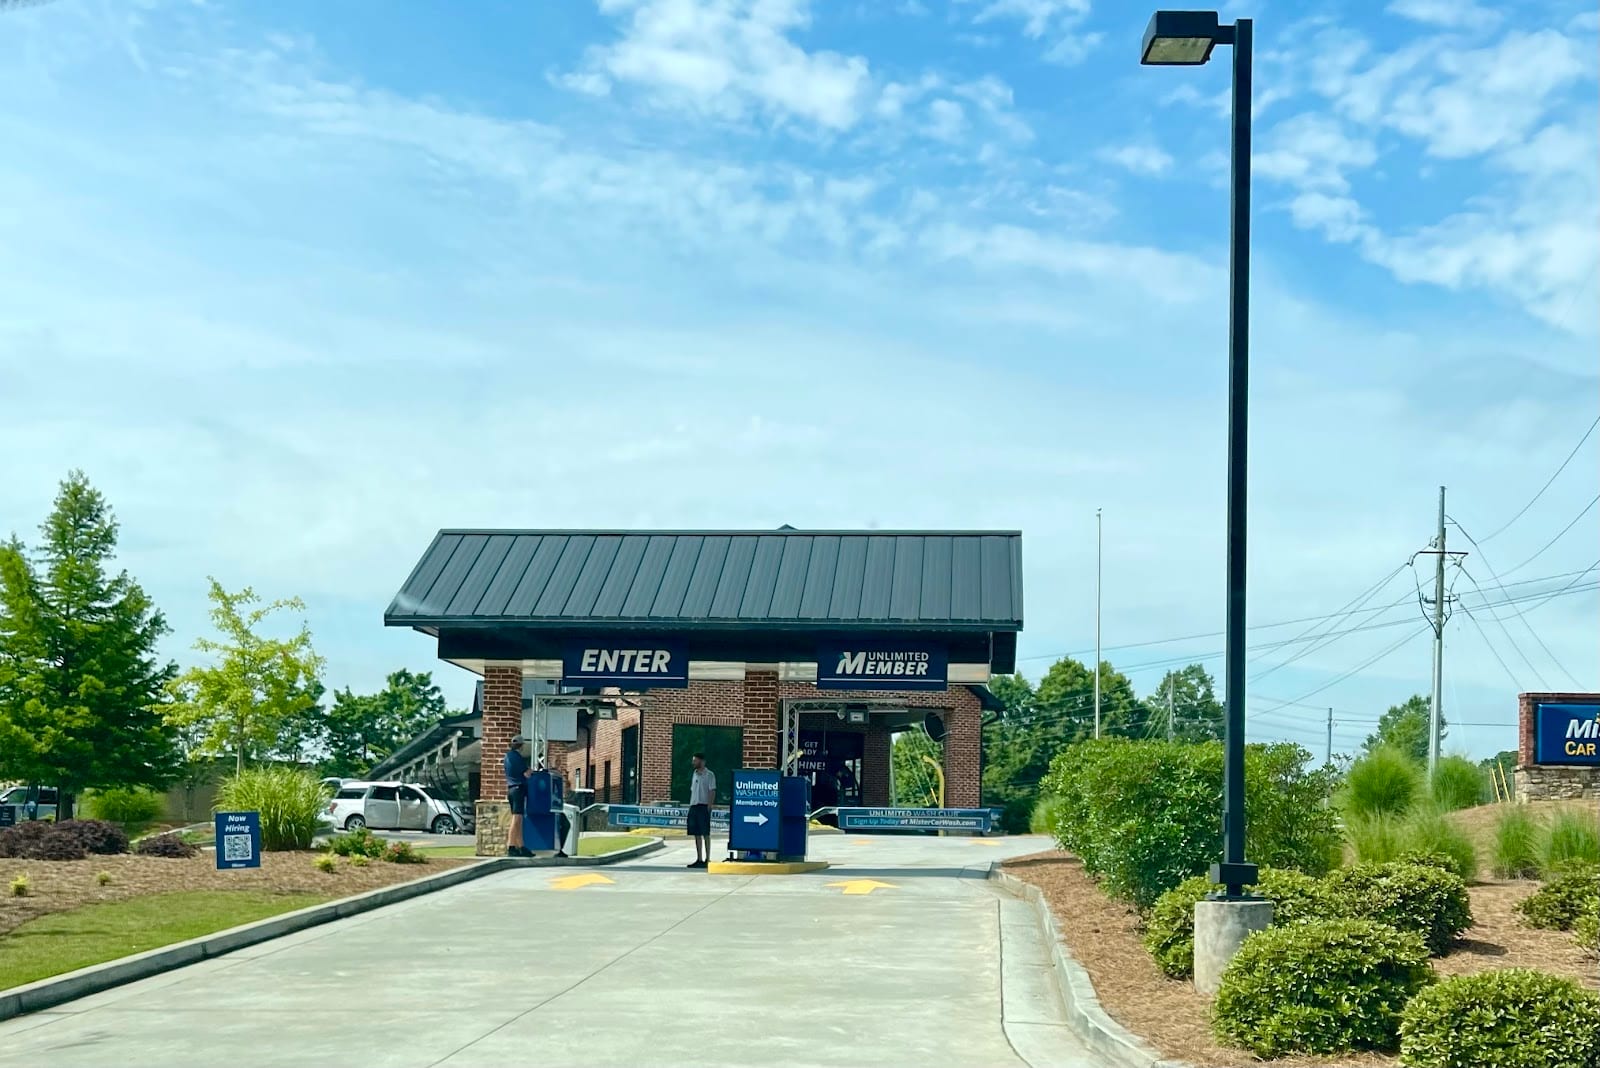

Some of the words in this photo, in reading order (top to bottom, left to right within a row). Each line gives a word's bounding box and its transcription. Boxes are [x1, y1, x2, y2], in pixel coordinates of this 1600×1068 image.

[580, 649, 672, 673] ENTER
[868, 652, 929, 661] UNLIMITED
[836, 652, 929, 675] MEMBER
[1565, 713, 1600, 739] Mi
[1565, 741, 1597, 756] CAR
[798, 761, 826, 770] HINE!
[736, 781, 779, 790] Unlimited
[763, 800, 778, 808] Only
[639, 808, 680, 816] UNLIMITED
[853, 818, 868, 826] Sign
[869, 818, 878, 826] Up
[880, 818, 899, 827] Today
[225, 824, 250, 833] Hiring
